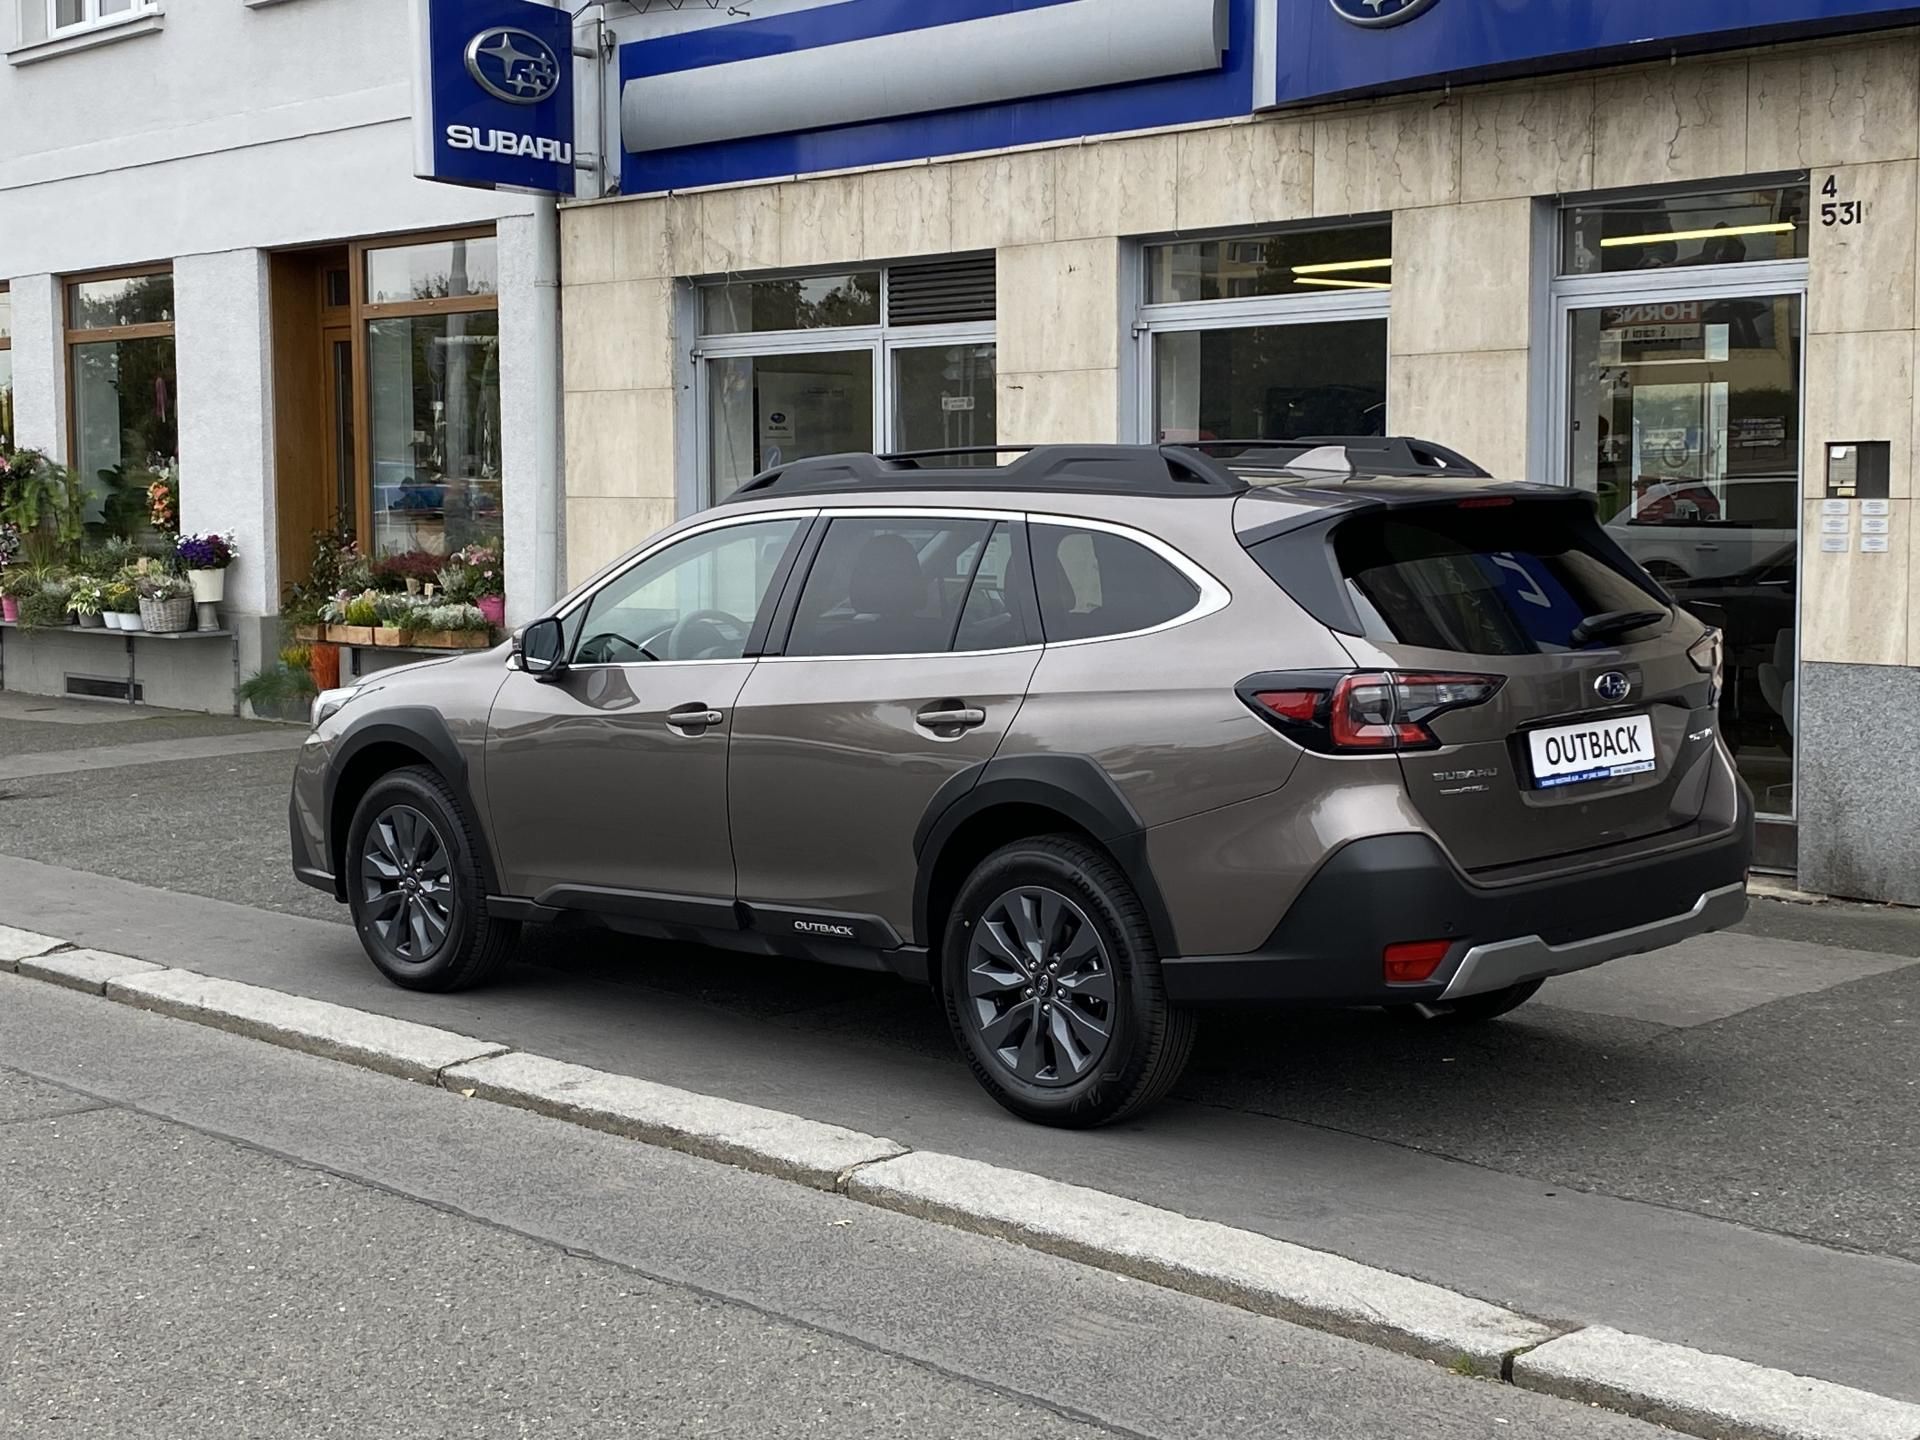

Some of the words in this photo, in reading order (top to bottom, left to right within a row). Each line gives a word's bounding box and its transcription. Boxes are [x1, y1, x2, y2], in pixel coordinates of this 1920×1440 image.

[446, 124, 572, 165] SUBARU
[1821, 174, 1837, 198] 4
[1821, 200, 1862, 226] 531
[1545, 724, 1641, 766] OUTBACK
[1432, 767, 1498, 781] SUBARU
[794, 920, 854, 936] OUTBACK
